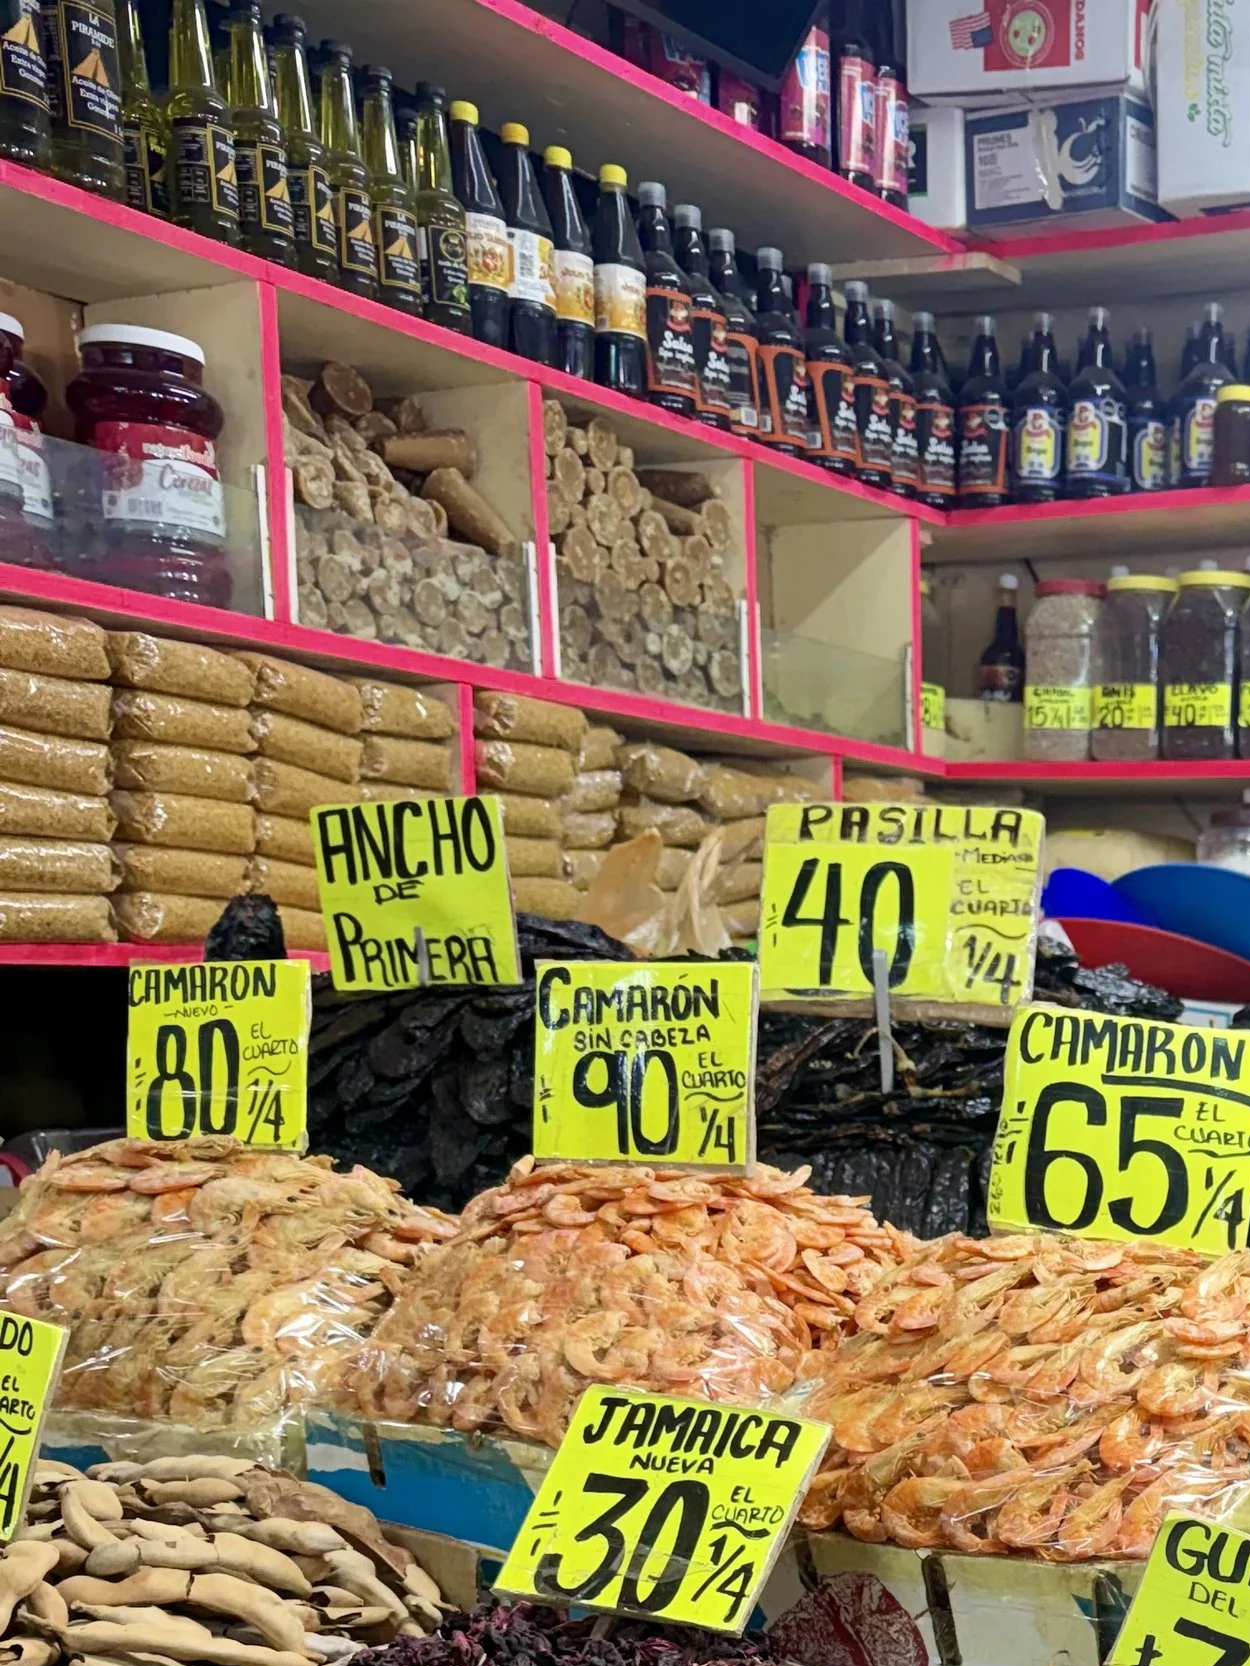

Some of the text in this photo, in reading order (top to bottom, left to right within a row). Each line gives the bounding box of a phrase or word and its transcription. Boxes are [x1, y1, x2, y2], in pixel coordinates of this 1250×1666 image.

[71, 21, 115, 48] PIRAMIDE
[88, 13, 100, 27] LA
[663, 331, 694, 355] Salsa
[1100, 706, 1124, 728] 20
[1172, 703, 1196, 726] 40
[317, 796, 497, 886] ANCHO
[801, 805, 1021, 844] PASILLA
[374, 880, 424, 905] DE
[957, 879, 989, 896] EL
[782, 857, 914, 989] 40
[129, 963, 277, 1008] CAMARON
[962, 934, 1022, 1004] 1/4
[538, 967, 720, 1031] CAMARÓN
[242, 1038, 299, 1062] CUARTO
[250, 1022, 272, 1040] EL
[573, 1024, 712, 1049] SIN CABEZA
[1019, 1011, 1246, 1081] CAMARON
[698, 1052, 723, 1068] EL
[146, 1018, 239, 1142] 80
[681, 1069, 746, 1090] CUARTO
[245, 1078, 286, 1144] 1/4
[572, 1049, 681, 1156] 90
[1196, 1101, 1227, 1123] EL
[698, 1108, 736, 1164] 1/4
[1024, 1081, 1190, 1236] 65
[1191, 1167, 1245, 1250] 1/4
[0, 1317, 34, 1357] DO
[1, 1375, 20, 1392] EL
[583, 1397, 803, 1469] JAMAICA
[629, 1452, 715, 1475] NUEVA
[731, 1485, 756, 1504] EL
[711, 1504, 785, 1525] CUARTO
[533, 1472, 711, 1614] 30
[690, 1534, 755, 1624] 1/4
[1188, 1581, 1239, 1619] DEL
